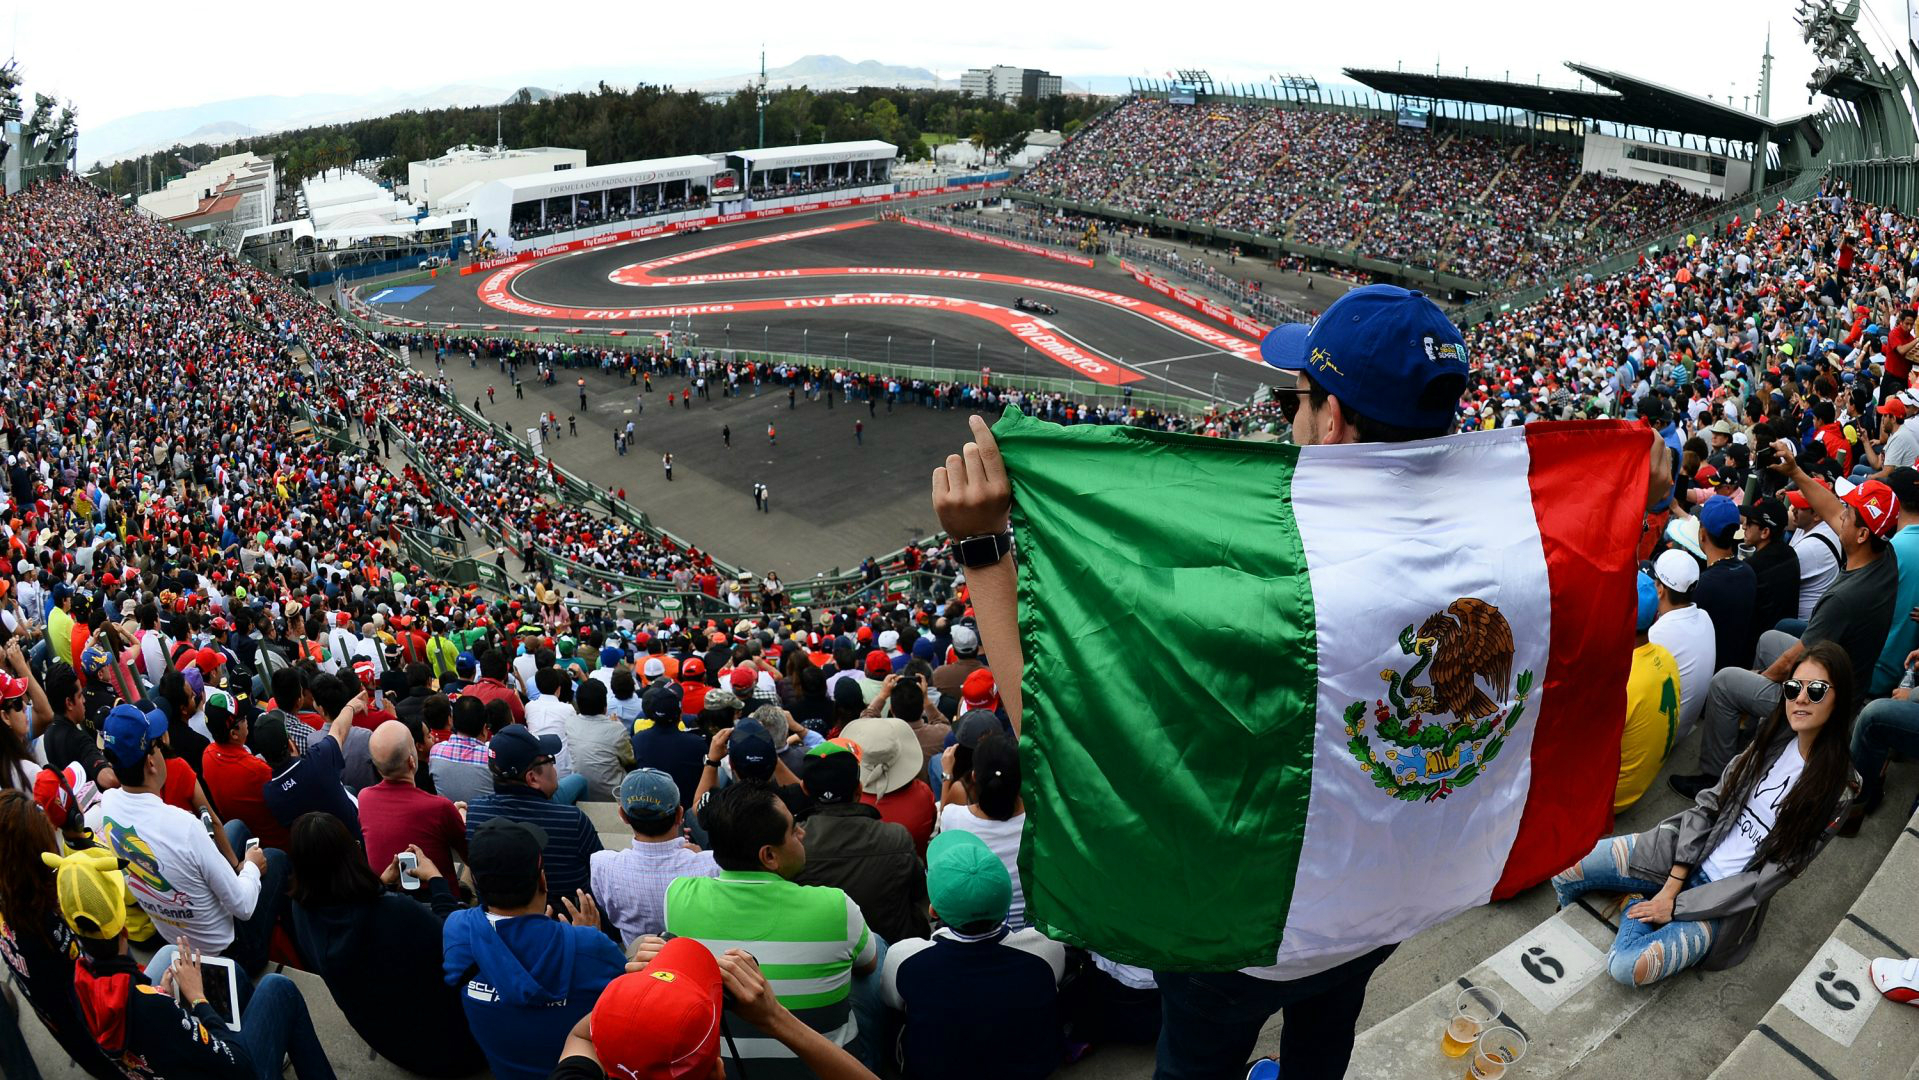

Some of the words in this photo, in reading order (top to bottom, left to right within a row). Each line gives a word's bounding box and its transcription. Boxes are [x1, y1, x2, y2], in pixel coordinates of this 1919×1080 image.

[550, 183, 584, 194] FORMULA
[585, 181, 600, 190] ONE
[601, 178, 634, 188] PADDOCK
[631, 230, 640, 238] Fly
[640, 226, 663, 235] Emirates
[584, 239, 594, 248] Fly
[594, 234, 618, 245] Emirates
[533, 249, 543, 259] Fly
[543, 244, 568, 256] Emirates
[480, 260, 491, 270] Fly
[492, 256, 518, 266] Emirates
[784, 298, 826, 308] Fly
[832, 296, 944, 308] Emirates
[584, 310, 624, 320] Fly
[629, 304, 734, 318] Emirates
[1208, 306, 1227, 321] Emirates
[1241, 320, 1260, 337] Emirates
[1010, 322, 1043, 339] Fly
[1032, 334, 1109, 374] Emirates
[281, 778, 296, 791] USA
[627, 795, 661, 806] BELGIUM
[157, 904, 194, 919] Senna
